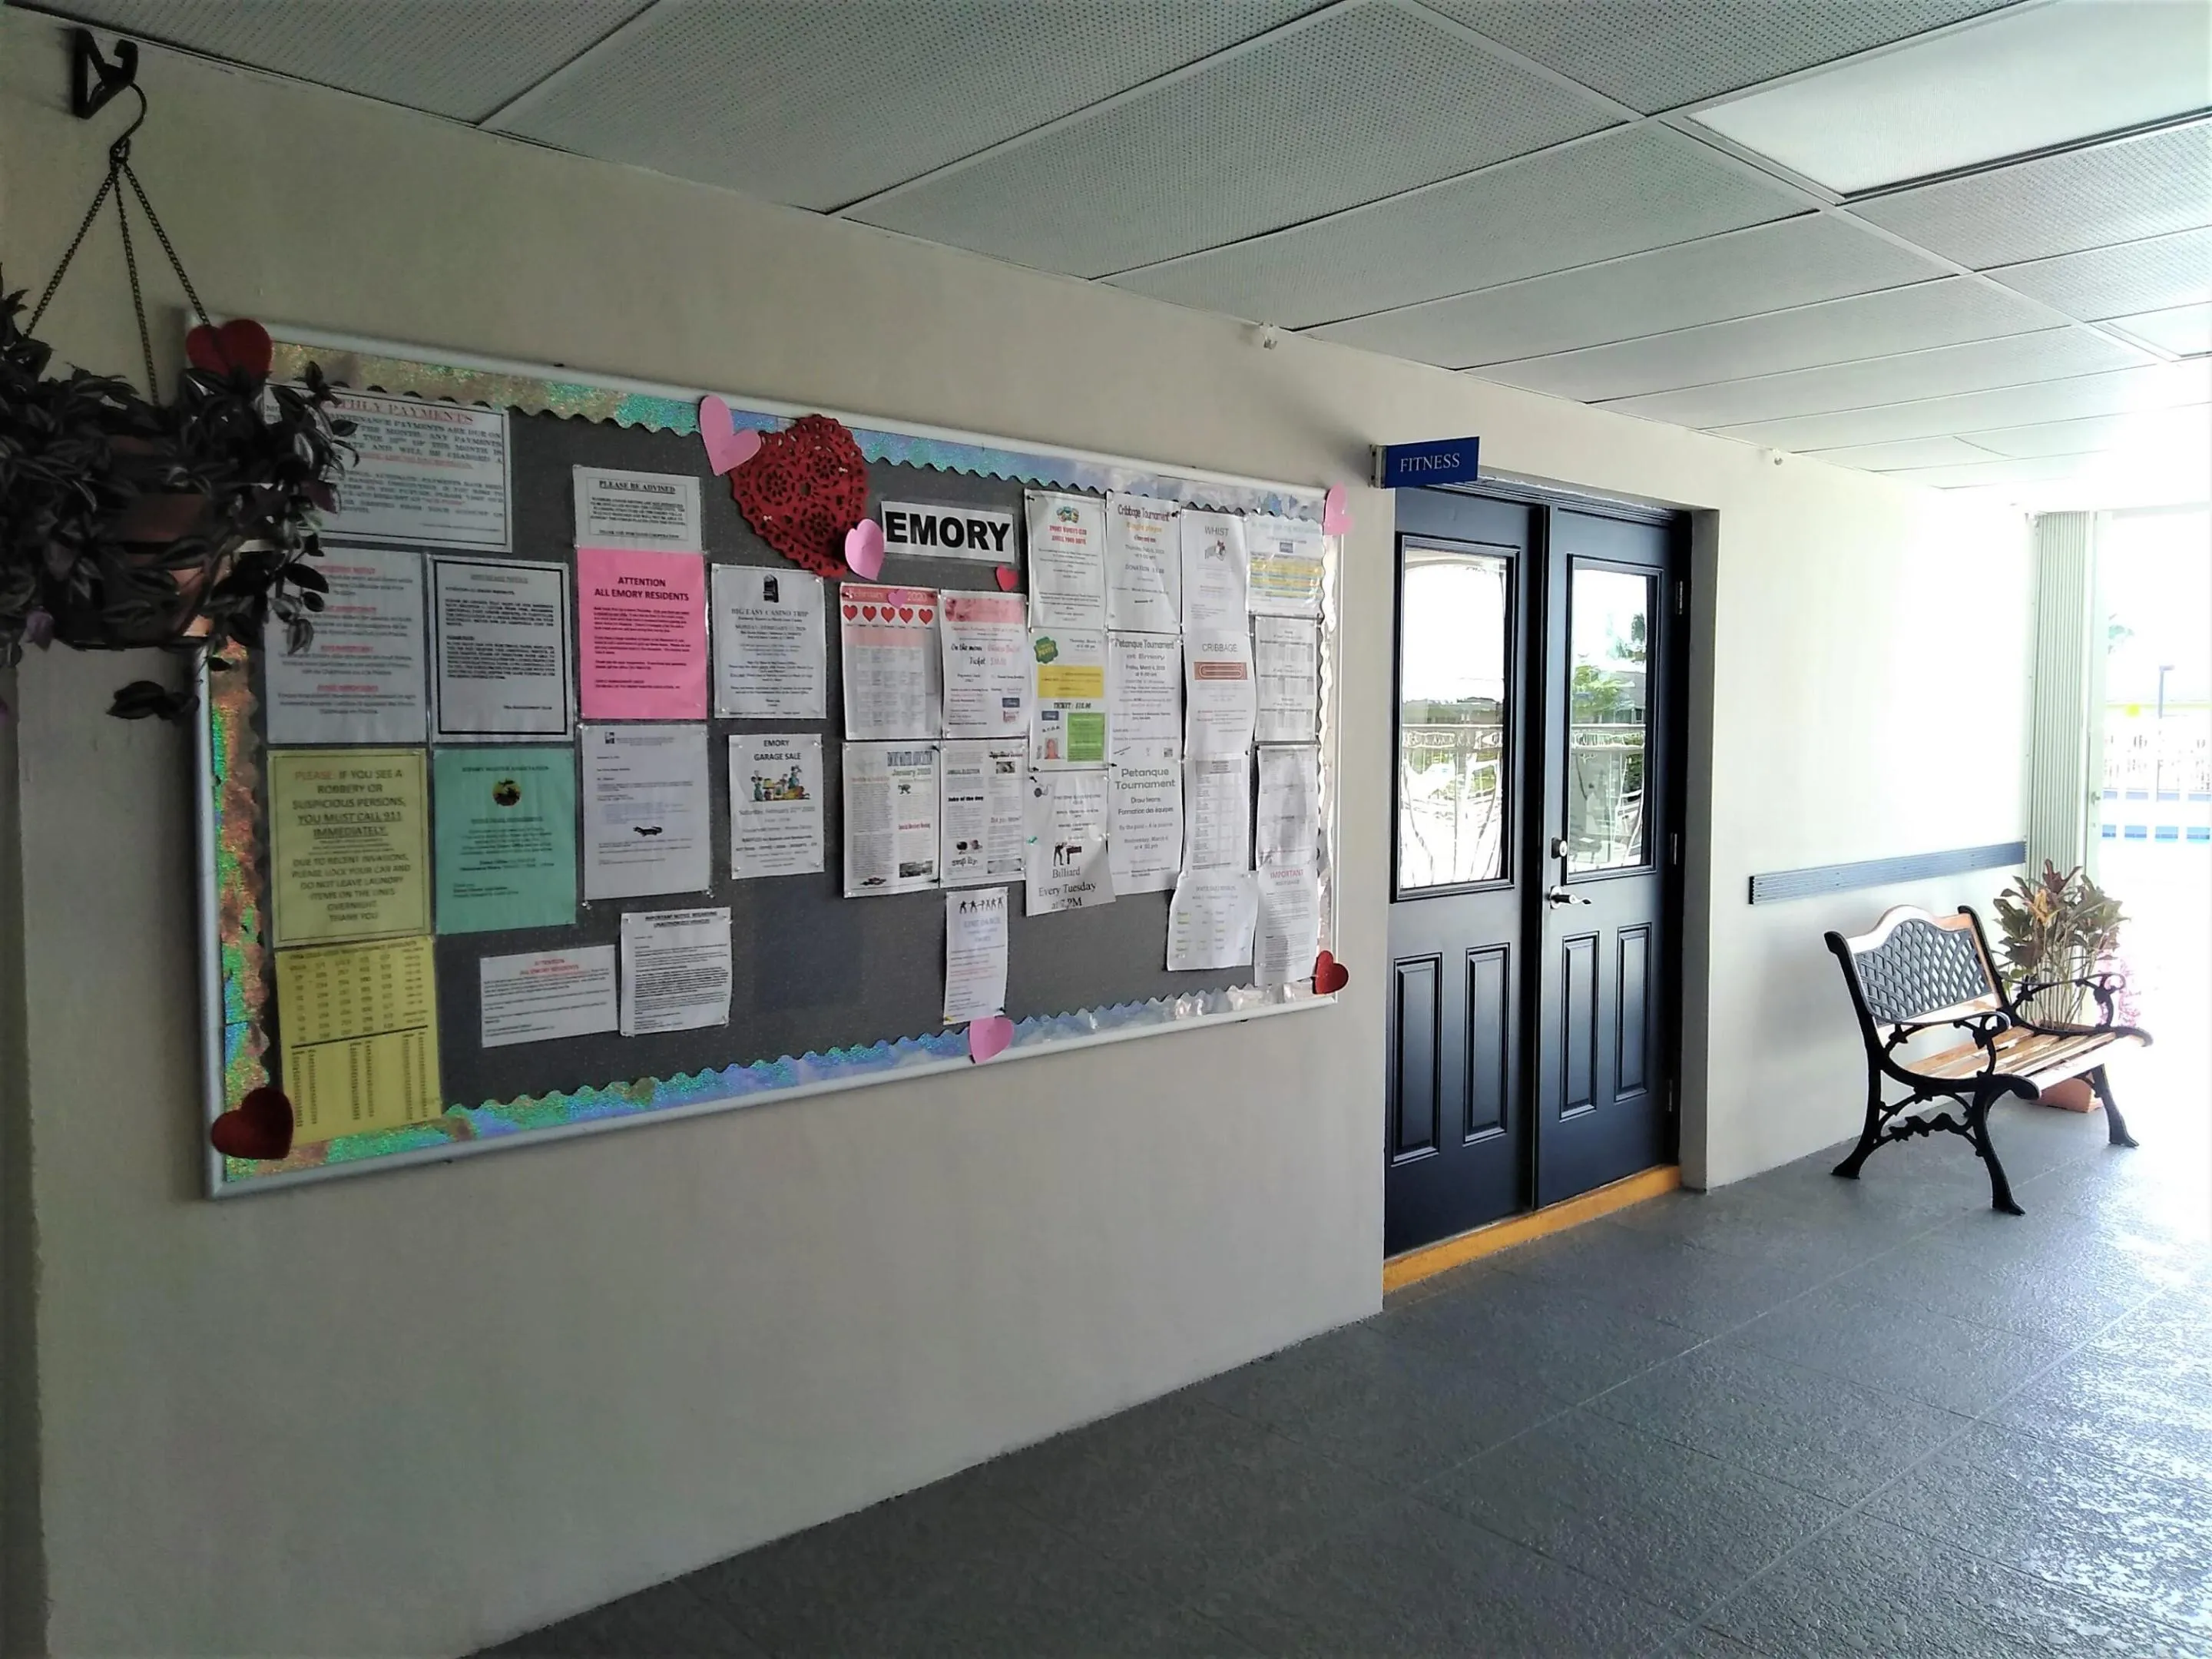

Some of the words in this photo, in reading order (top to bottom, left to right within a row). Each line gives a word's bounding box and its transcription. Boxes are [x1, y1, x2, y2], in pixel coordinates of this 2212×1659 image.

[388, 405, 474, 422] PAYMENTS
[1400, 452, 1460, 472] FITNESS
[599, 480, 628, 491] PLEASE
[630, 482, 639, 491] BE
[642, 484, 676, 495] ADVISED
[1118, 504, 1141, 520] Cribbage
[1142, 507, 1171, 522] Tournament
[885, 511, 1010, 551] EMORY
[1204, 525, 1229, 537] WHIST
[618, 577, 666, 587] ATTENTION
[594, 588, 610, 597] ALL
[612, 589, 643, 599] EMORY
[645, 591, 690, 601] RESIDENTS
[1202, 644, 1238, 652] CRIBBAGE
[763, 739, 790, 747] EMORY
[753, 753, 783, 761] GARAGE
[339, 770, 349, 780] IF
[351, 770, 373, 779] YOU
[376, 770, 392, 779] SEE
[396, 769, 402, 778] A
[1121, 768, 1169, 778] Petanque
[317, 784, 365, 794] ROBBERY
[368, 783, 383, 793] OR
[1115, 779, 1176, 790] Tournament
[293, 799, 355, 810] SUSPICIOUS
[298, 814, 321, 826] YOU
[324, 813, 355, 825] MUST
[357, 812, 382, 823] CALL
[383, 811, 402, 823] 911
[293, 859, 312, 867] DUE
[314, 858, 326, 866] TO
[327, 856, 359, 865] RECENT
[292, 869, 323, 879] PLEASE
[325, 868, 346, 876] LOCK
[349, 866, 373, 876] YOUR
[374, 865, 391, 874] CAR
[392, 863, 411, 873] AND
[1052, 867, 1081, 879] Billiard
[1270, 869, 1303, 879] IMPORTANT
[300, 881, 314, 890] DO
[316, 879, 334, 889] NOT
[336, 878, 362, 888] LEAVE
[363, 876, 405, 886] LAUNDRY
[310, 891, 336, 900] ITEMS
[339, 890, 353, 899] ON
[355, 889, 370, 898] THE
[1038, 887, 1061, 897] Every
[1062, 882, 1096, 894] Tuesday
